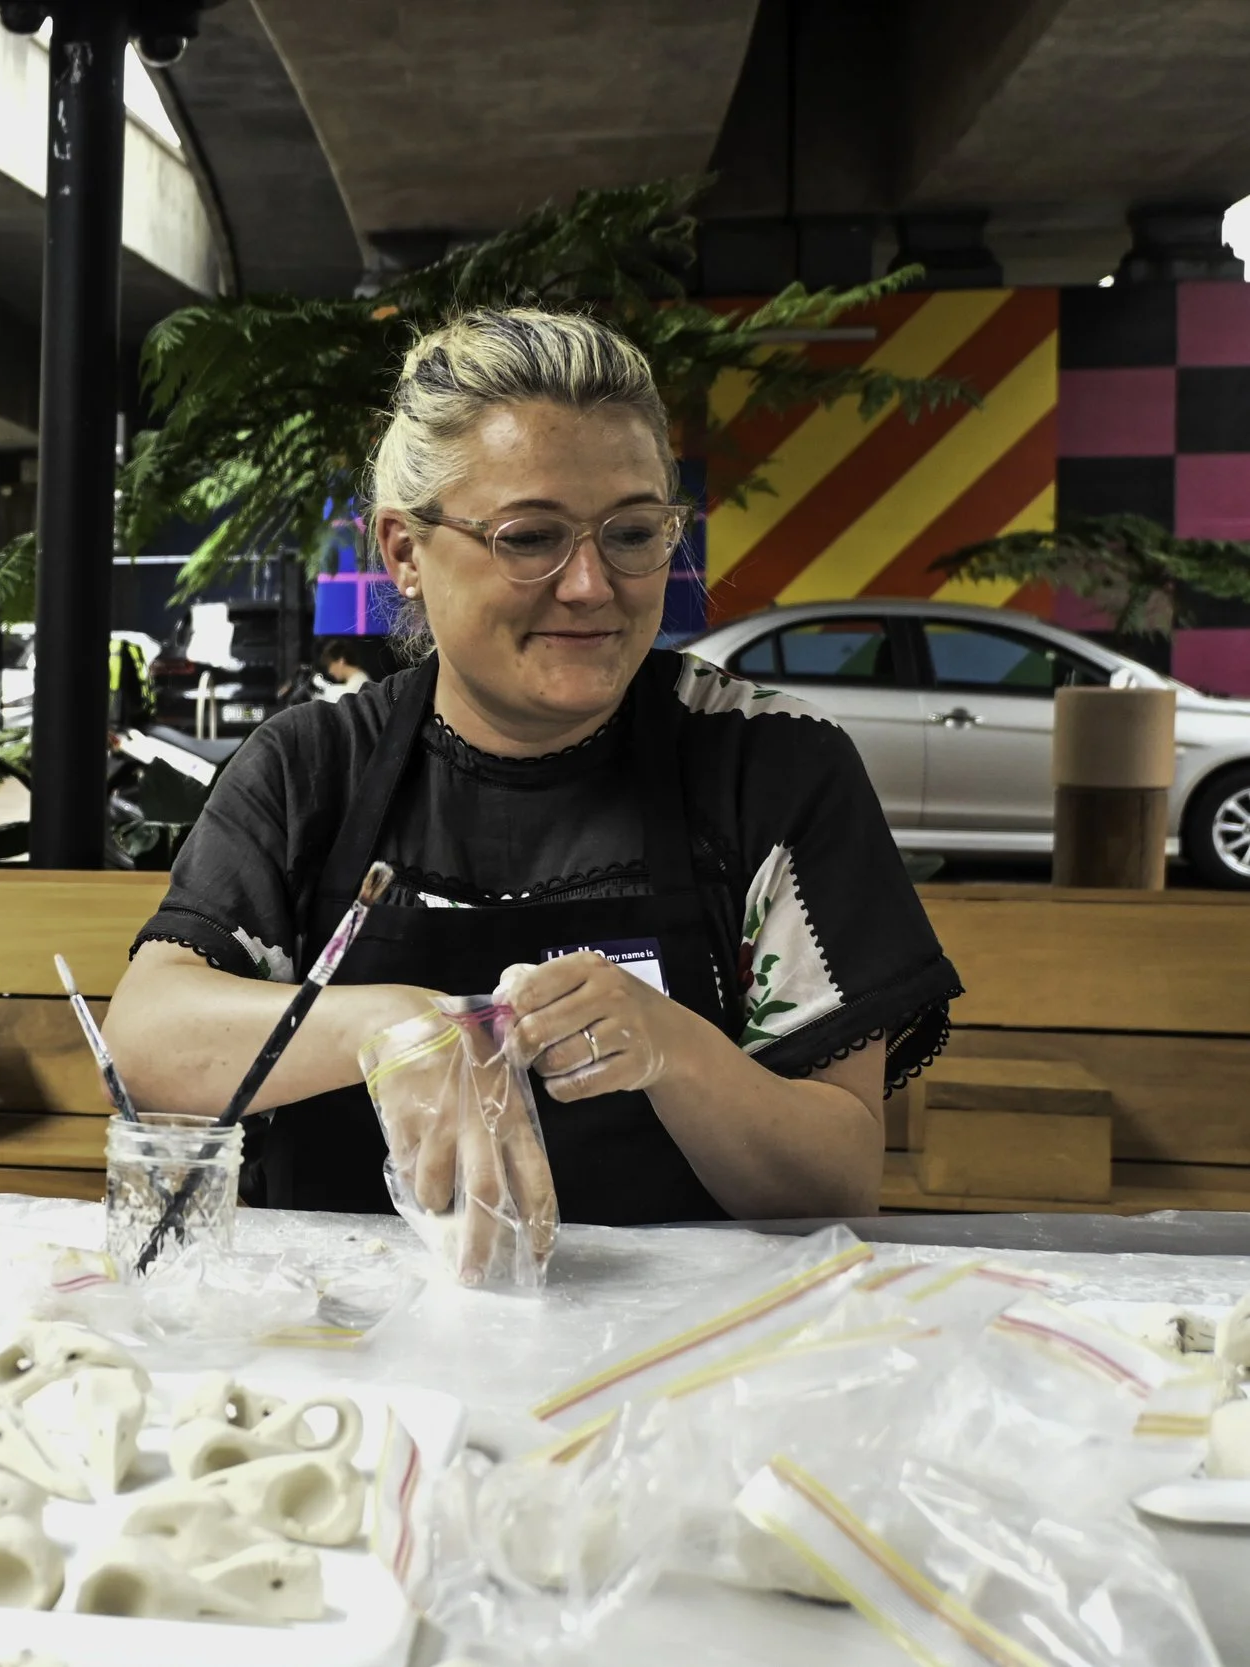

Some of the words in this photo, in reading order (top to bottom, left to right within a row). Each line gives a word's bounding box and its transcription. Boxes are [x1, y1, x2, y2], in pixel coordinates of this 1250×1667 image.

[607, 954, 620, 963] my
[621, 951, 645, 960] name
[646, 949, 655, 957] is
